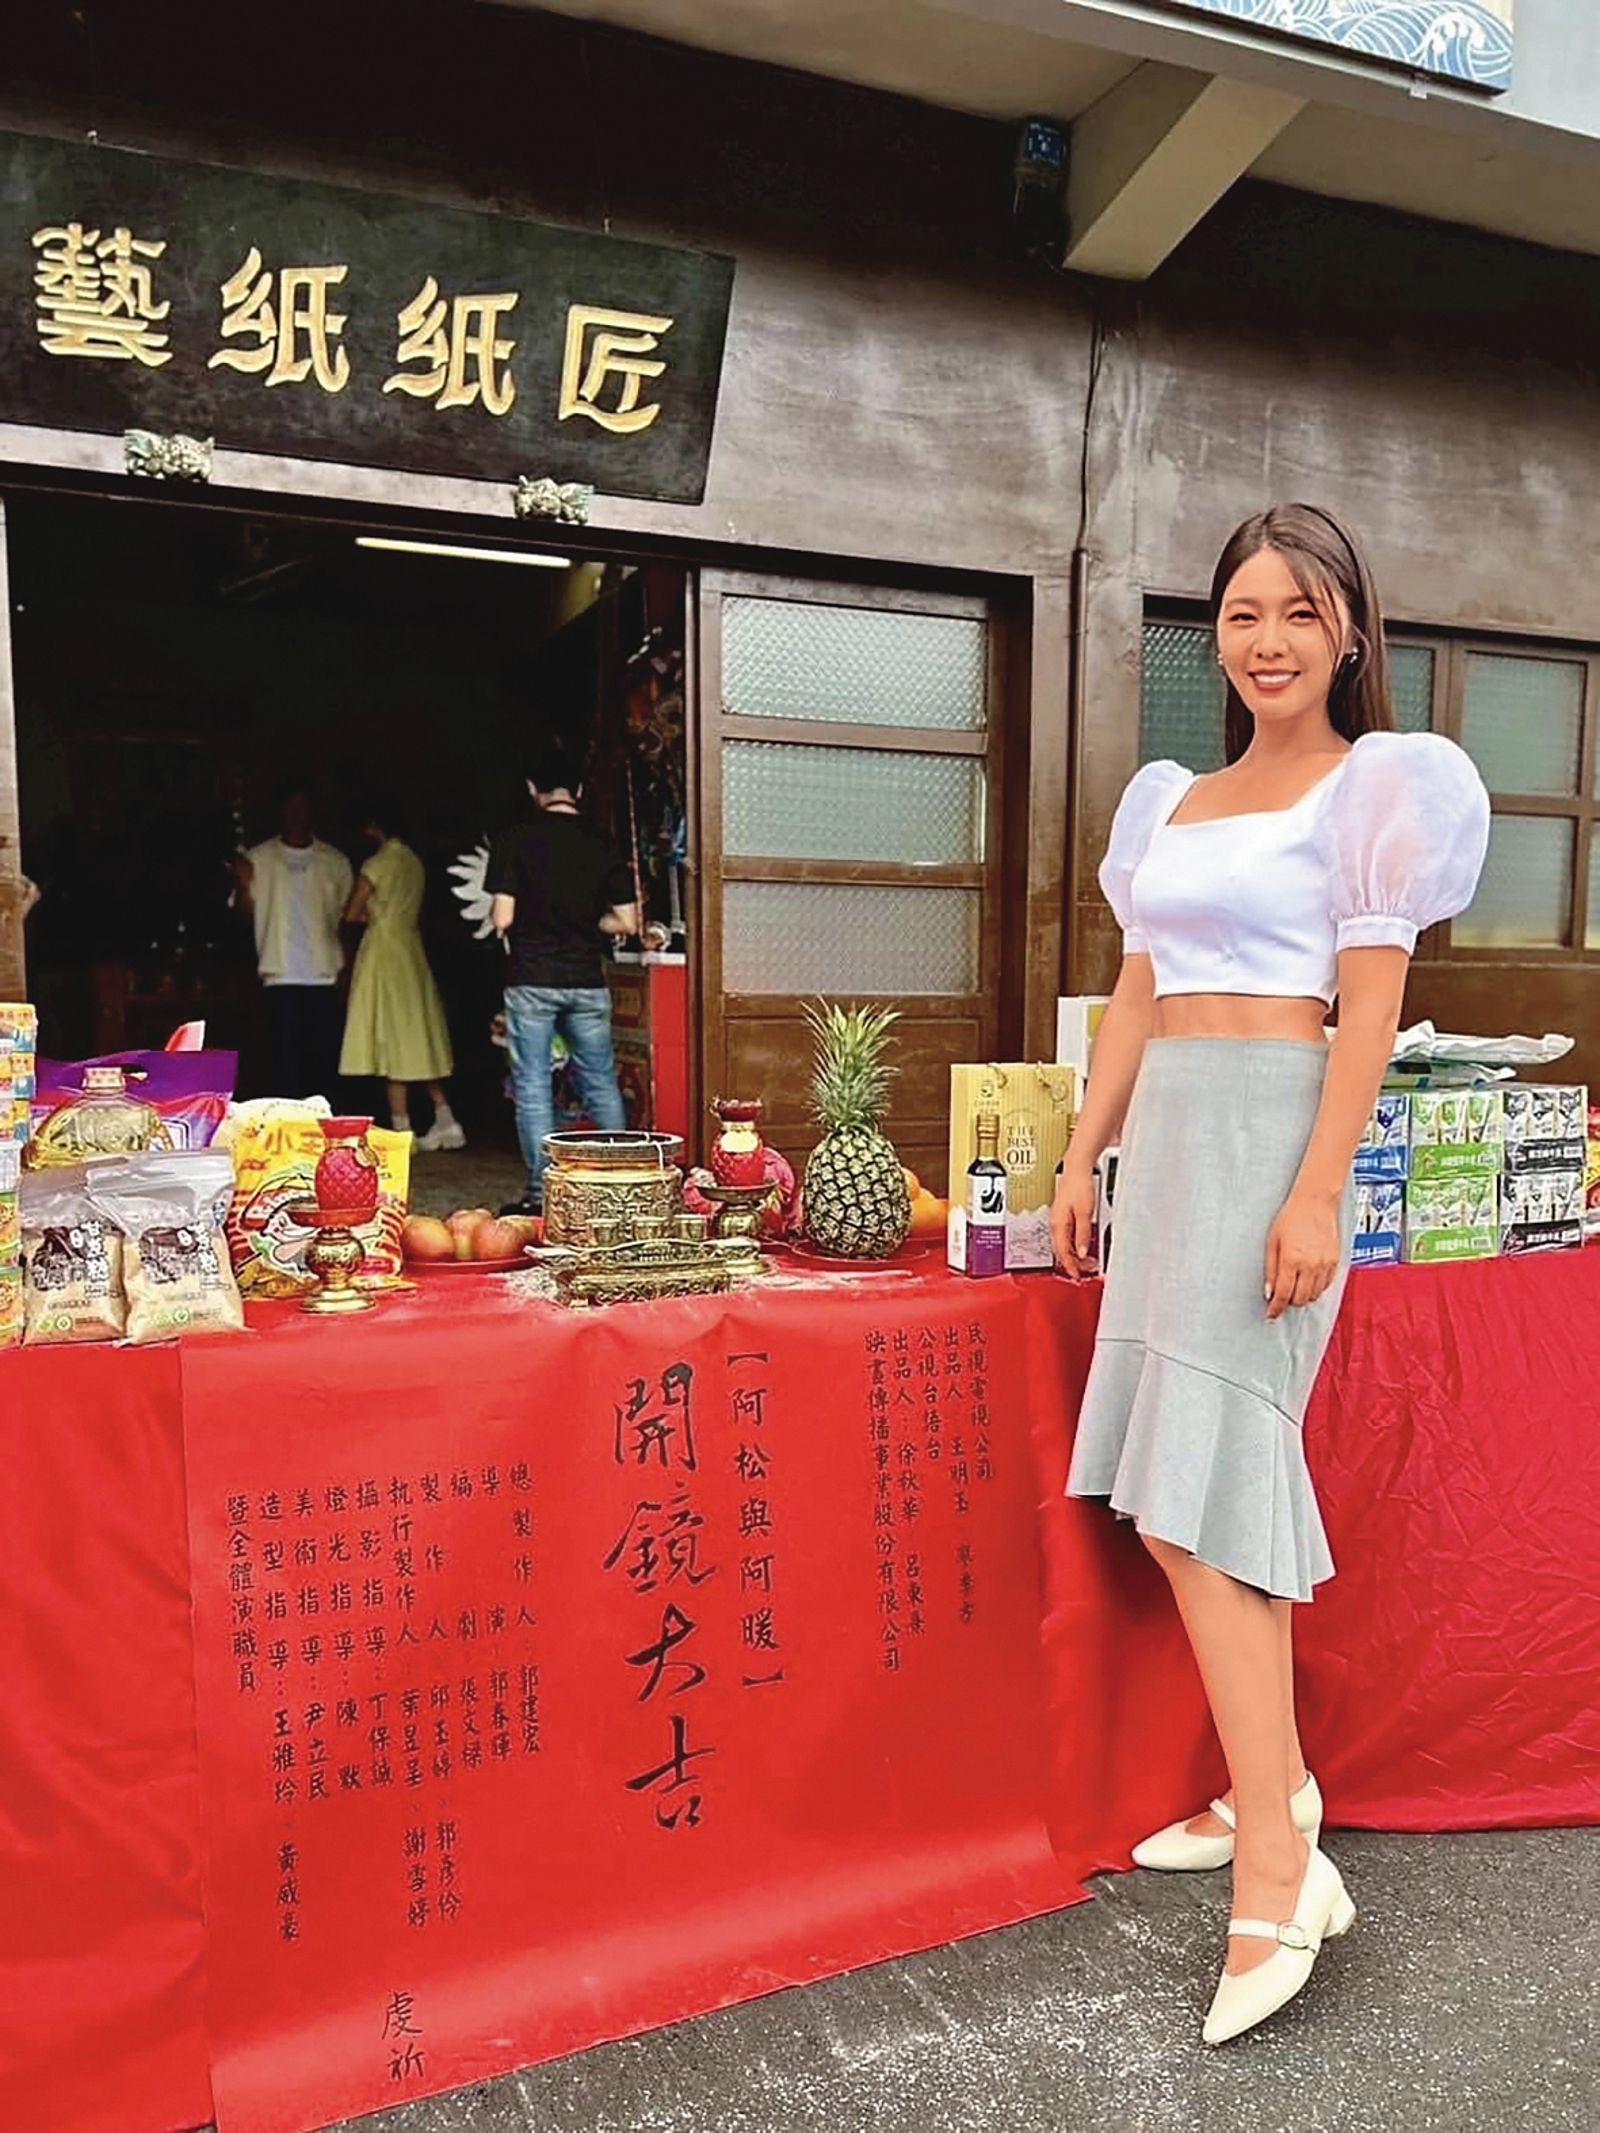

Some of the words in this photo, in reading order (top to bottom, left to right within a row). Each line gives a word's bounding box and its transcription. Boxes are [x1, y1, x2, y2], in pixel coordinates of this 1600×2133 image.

[1006, 1149, 1036, 1166] OIL
[227, 1493, 259, 1693] 暨全體演職員
[604, 1361, 717, 1830] 開鏡大吉
[381, 1991, 425, 2080] 虔祈
